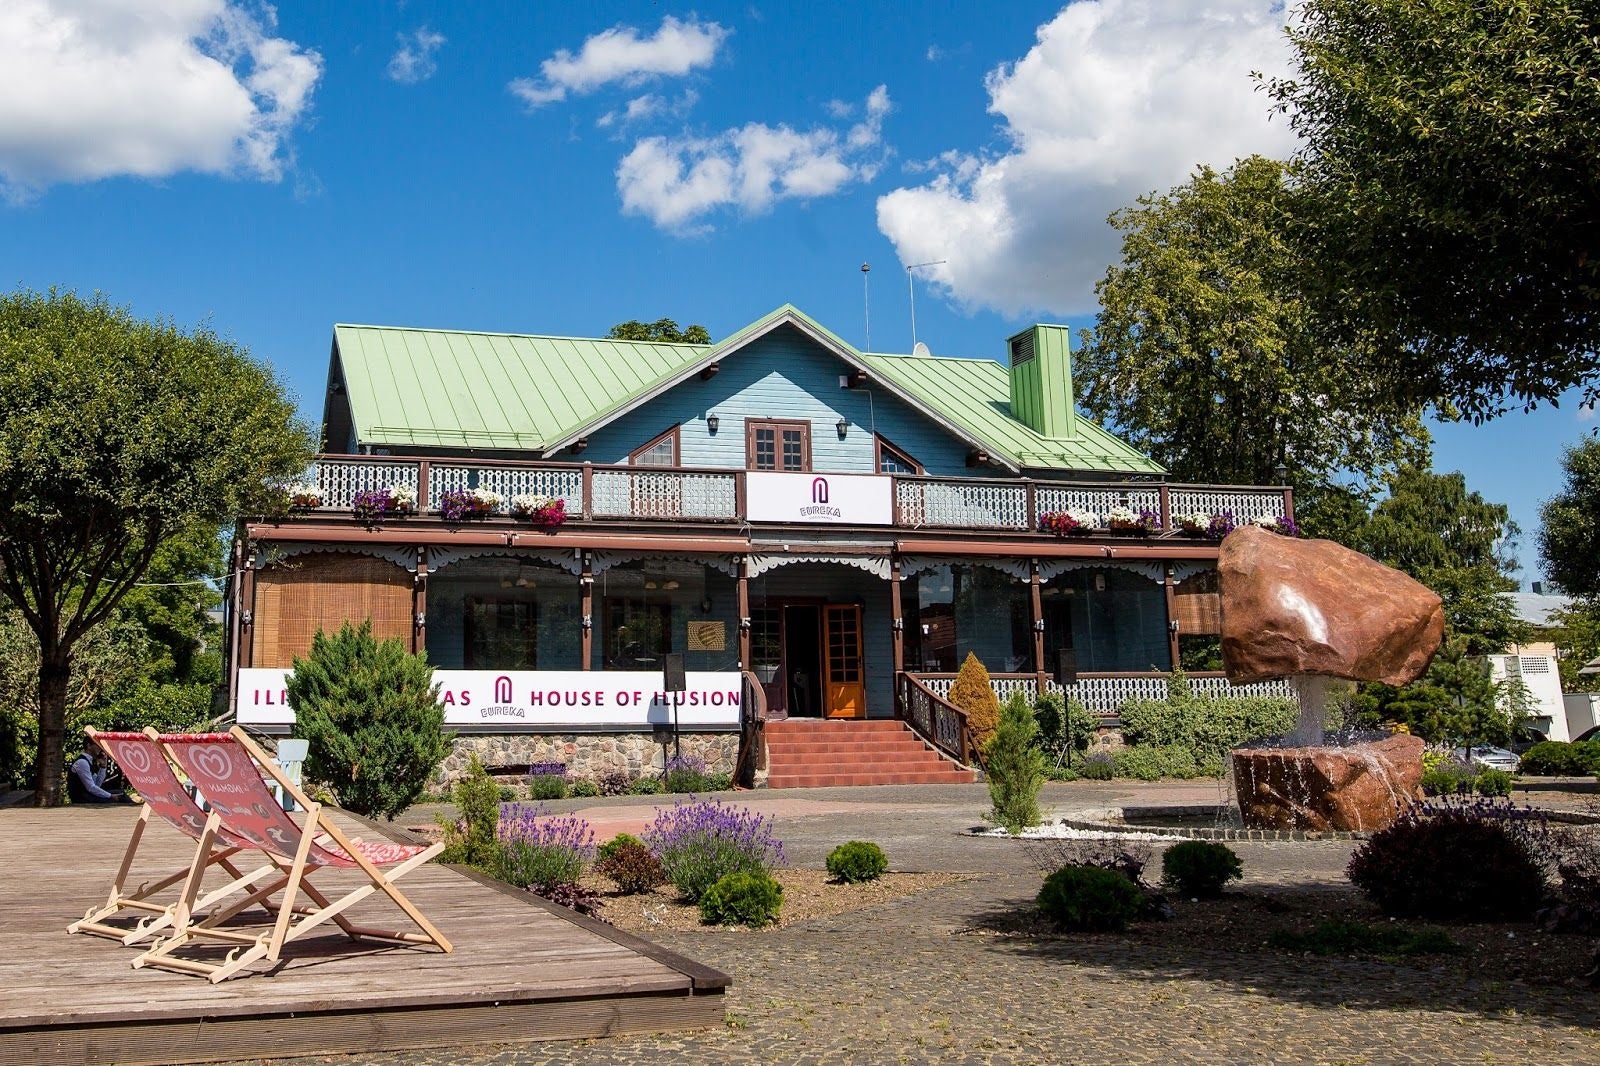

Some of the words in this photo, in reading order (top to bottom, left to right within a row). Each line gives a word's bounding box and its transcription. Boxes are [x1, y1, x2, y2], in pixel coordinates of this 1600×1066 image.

[799, 506, 841, 517] EUREKA
[530, 691, 605, 707] HOUSE
[615, 691, 643, 707] OF
[480, 706, 526, 718] EUREKA
